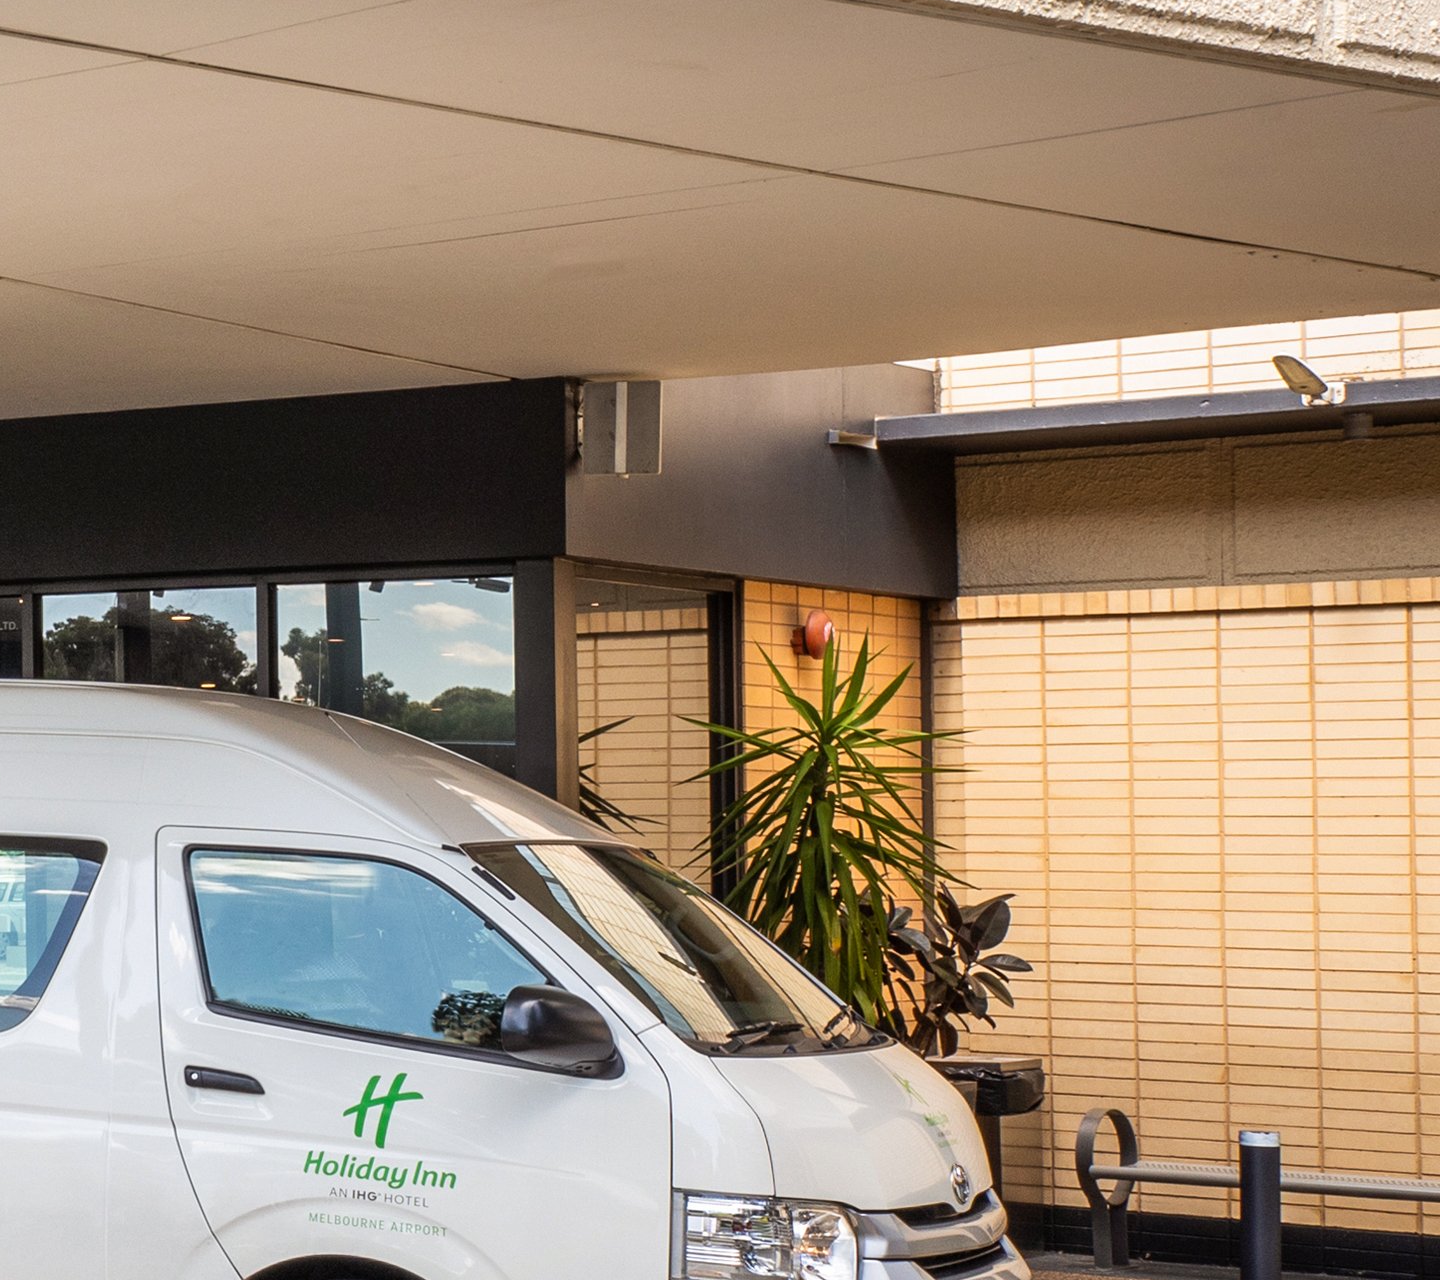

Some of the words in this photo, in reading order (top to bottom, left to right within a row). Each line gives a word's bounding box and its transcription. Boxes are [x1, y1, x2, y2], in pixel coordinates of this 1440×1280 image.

[302, 1150, 408, 1189] Holiday
[412, 1160, 457, 1190] Inn
[329, 1187, 348, 1199] AN
[384, 1193, 429, 1208] HOTEL
[308, 1212, 385, 1230] MELBOURNE
[390, 1221, 448, 1238] AIRPORT
